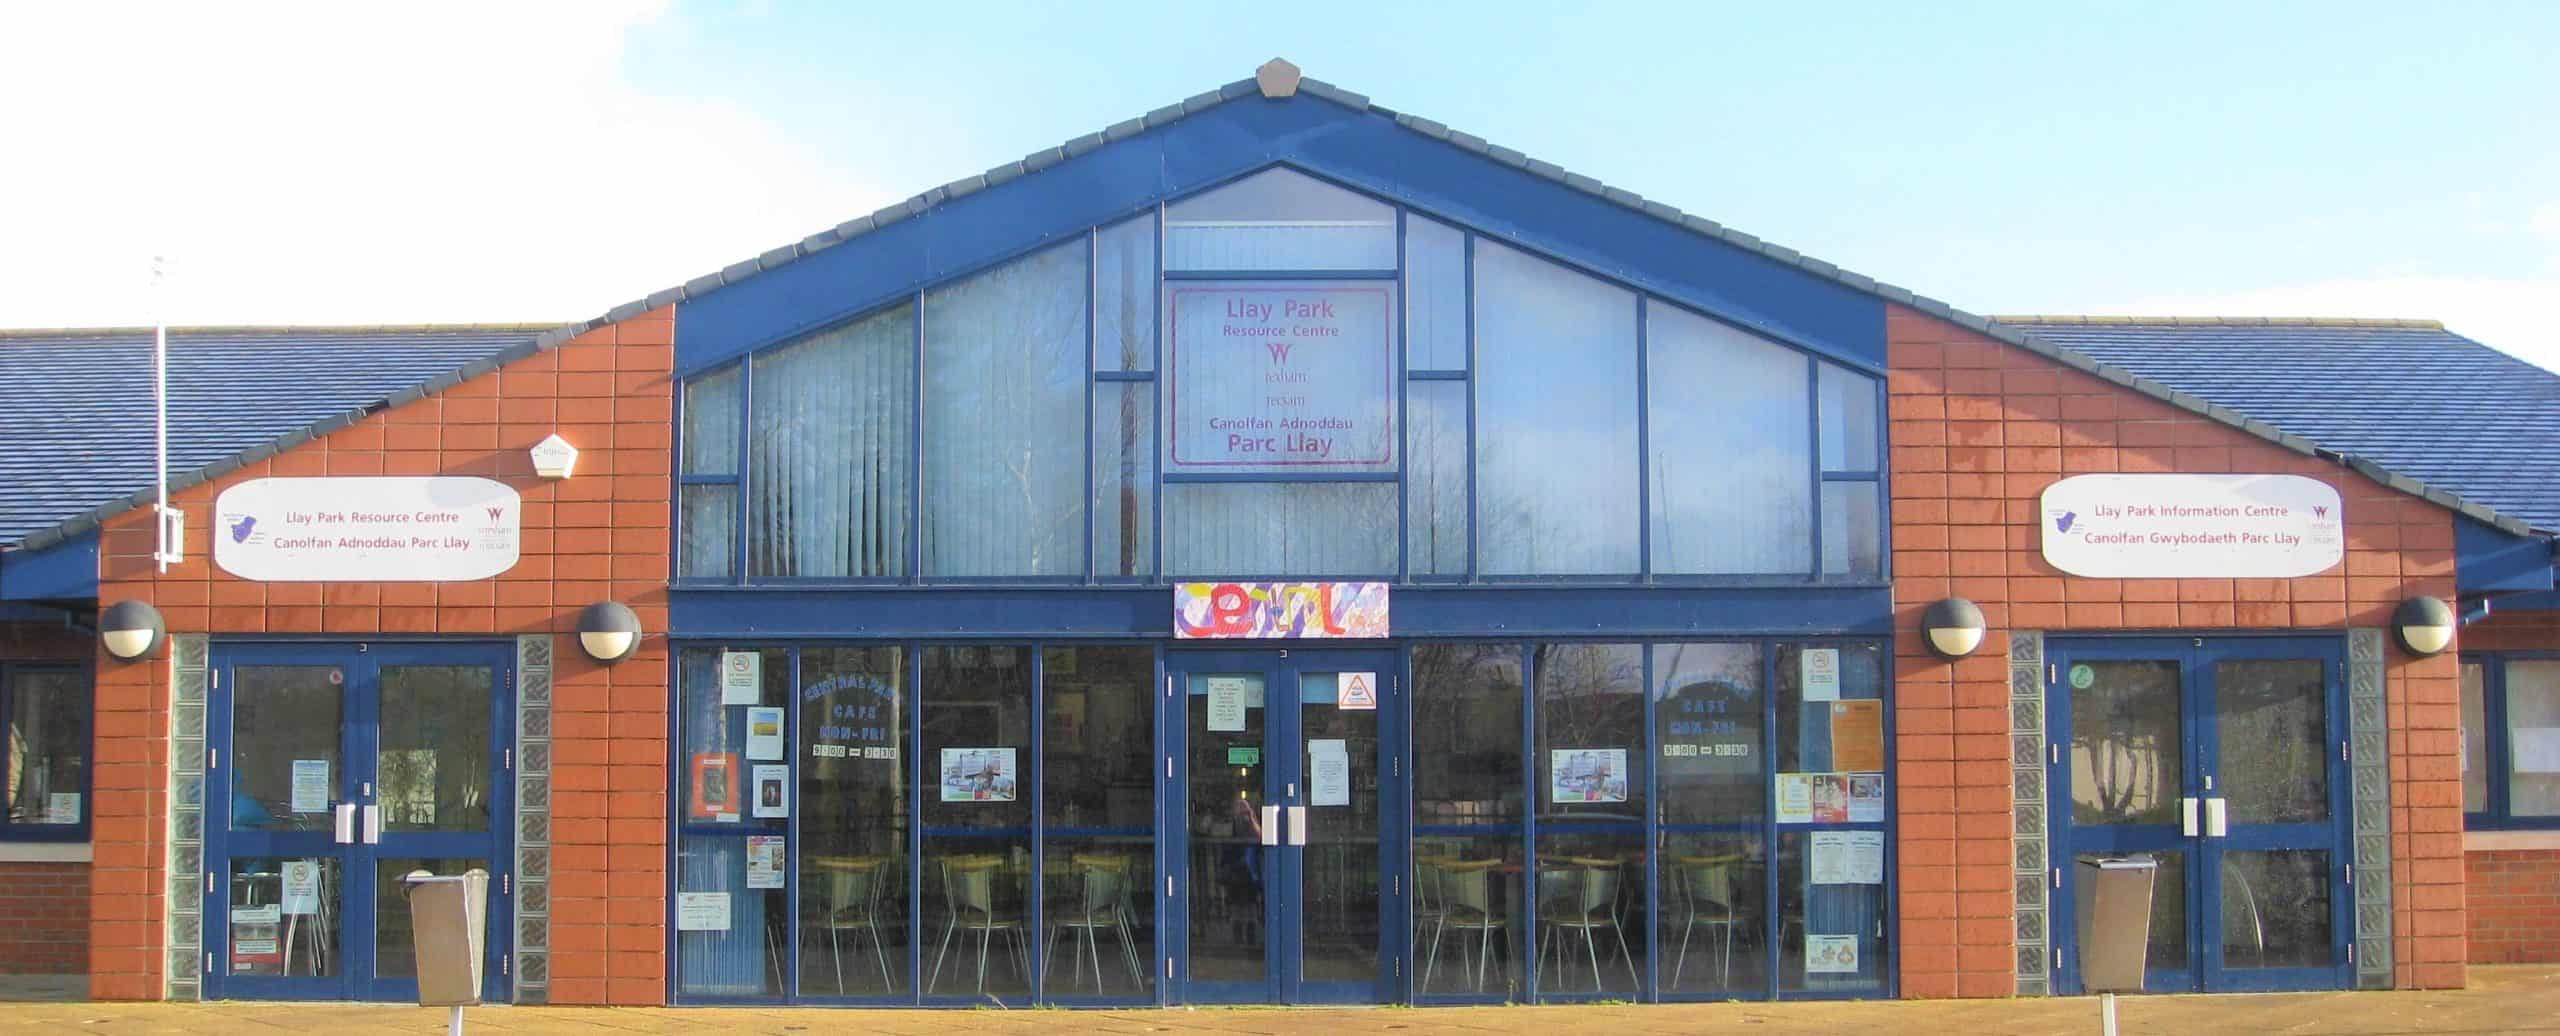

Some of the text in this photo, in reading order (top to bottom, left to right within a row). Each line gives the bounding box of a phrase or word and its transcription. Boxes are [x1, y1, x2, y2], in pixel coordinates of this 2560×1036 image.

[1227, 299, 1334, 322] Llay Park
[1223, 325, 1339, 337] Resource Centre
[1209, 416, 1353, 430] Canolfan Adnoddau
[1228, 432, 1333, 458] Parc Llay
[286, 511, 460, 526] Llay Park Resource Centre
[2095, 504, 2289, 518] Llay Park Information Centre
[273, 536, 333, 549] Canolfan
[338, 536, 406, 549] Adnoddau
[411, 537, 438, 549] Parc
[443, 536, 470, 551] Llay
[2084, 532, 2145, 545] Canolfan
[2149, 532, 2237, 547] Gwybodaeth
[2241, 533, 2269, 545] Parc
[2274, 532, 2301, 547] Llay
